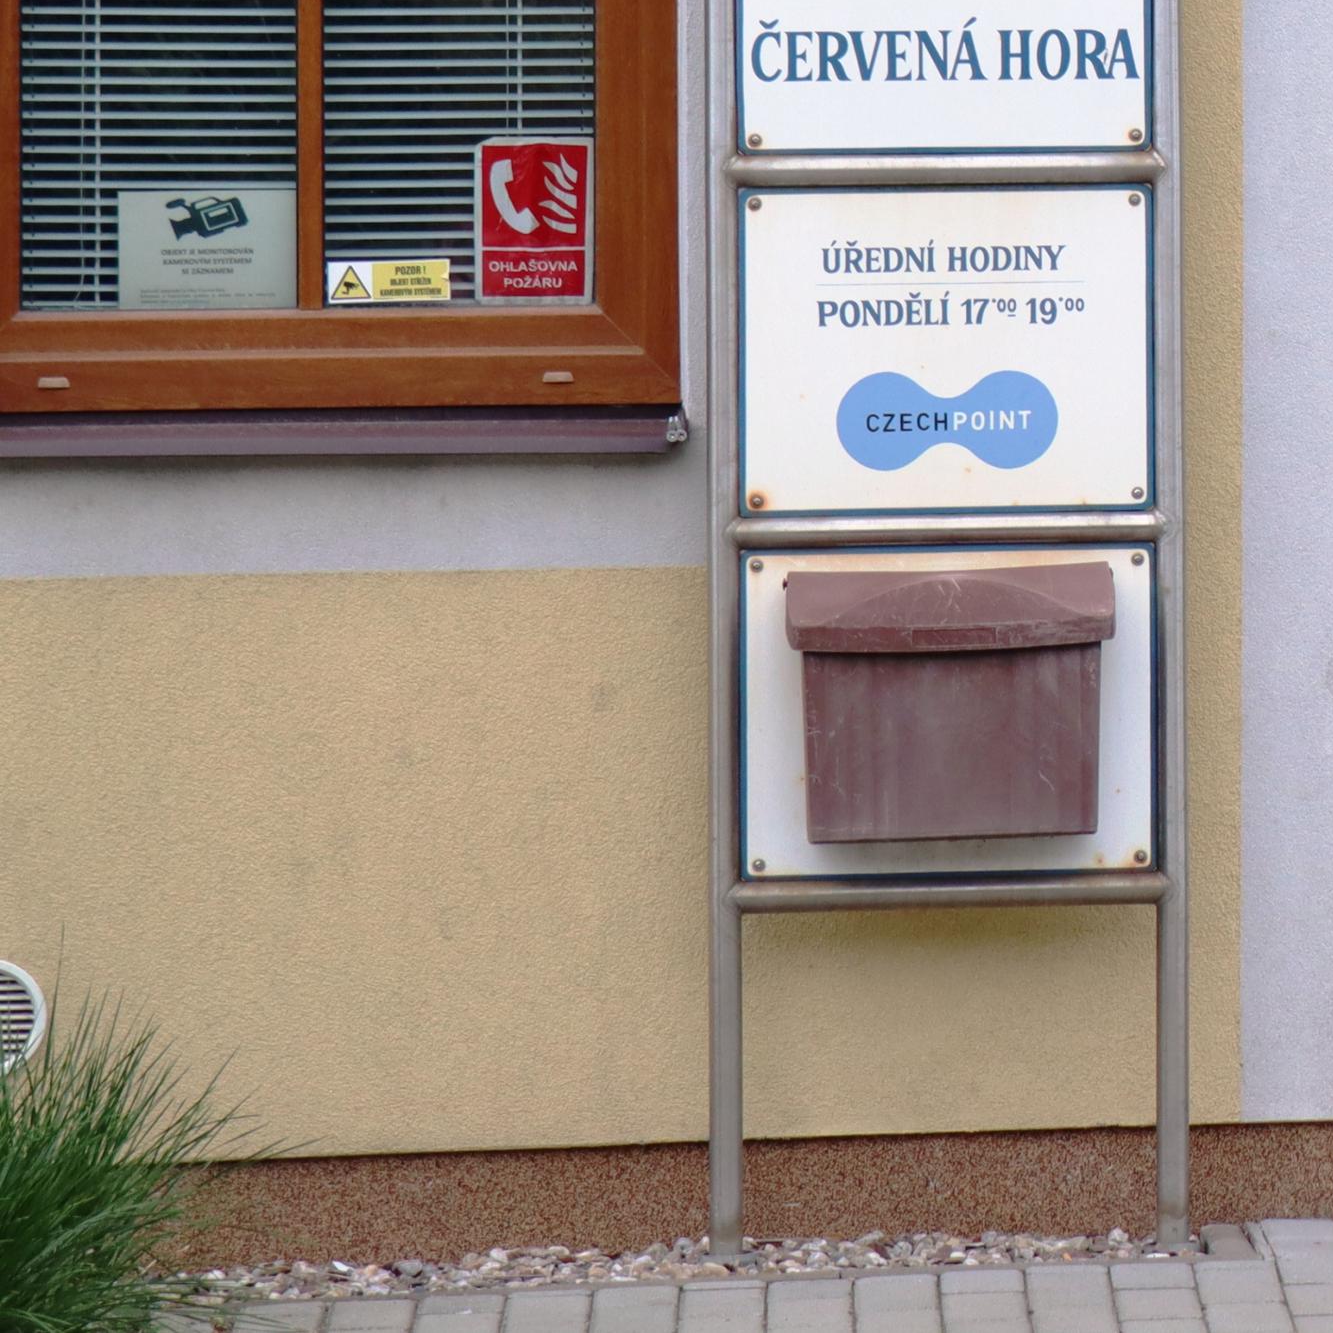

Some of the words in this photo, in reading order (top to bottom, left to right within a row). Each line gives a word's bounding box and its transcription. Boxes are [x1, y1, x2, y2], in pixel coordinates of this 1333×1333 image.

[751, 16, 990, 82] ČERVENÁ
[997, 28, 1140, 80] HORA
[488, 258, 578, 272] OHLAŠOVNA
[821, 239, 936, 274] ÚŘEDNÍ
[947, 244, 1066, 272] HODINY
[503, 275, 563, 288] POŽÁRU
[817, 290, 950, 328] PONDĚLÍ
